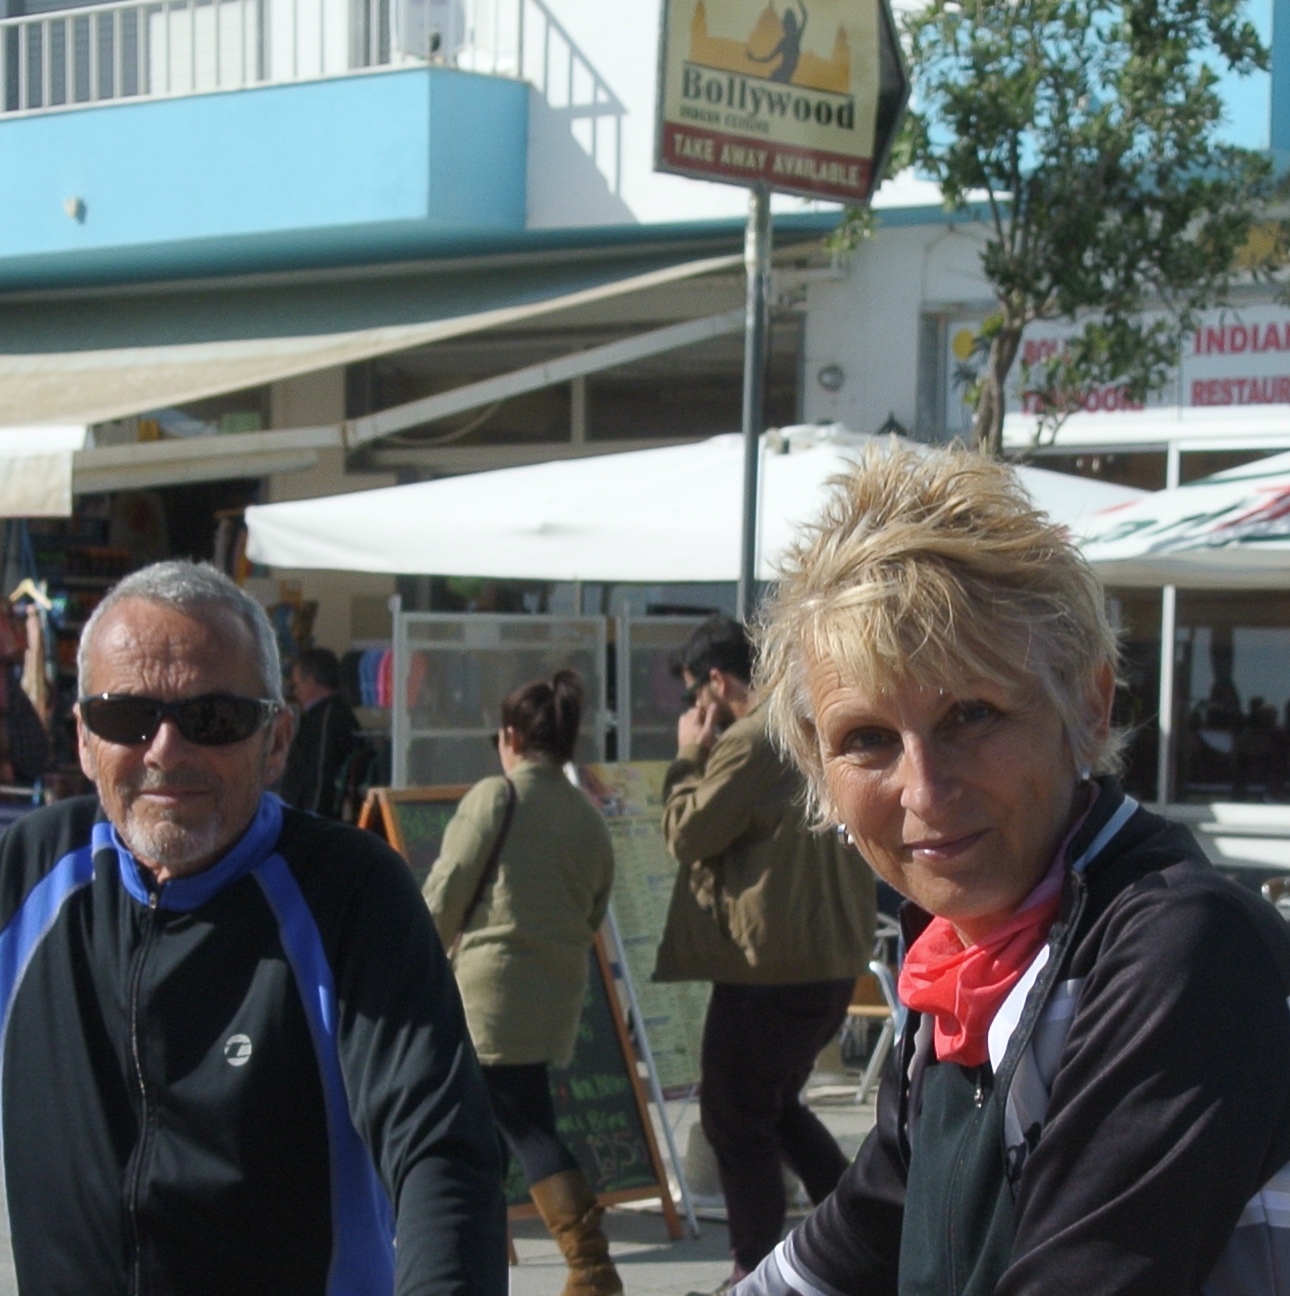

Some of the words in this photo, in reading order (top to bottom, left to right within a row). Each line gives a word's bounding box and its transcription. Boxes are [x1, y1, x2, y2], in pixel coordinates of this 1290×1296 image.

[681, 66, 855, 130] Bollywood
[674, 132, 716, 163] TAKE
[719, 142, 769, 171] AWAY
[771, 151, 860, 187] AVAILABLE
